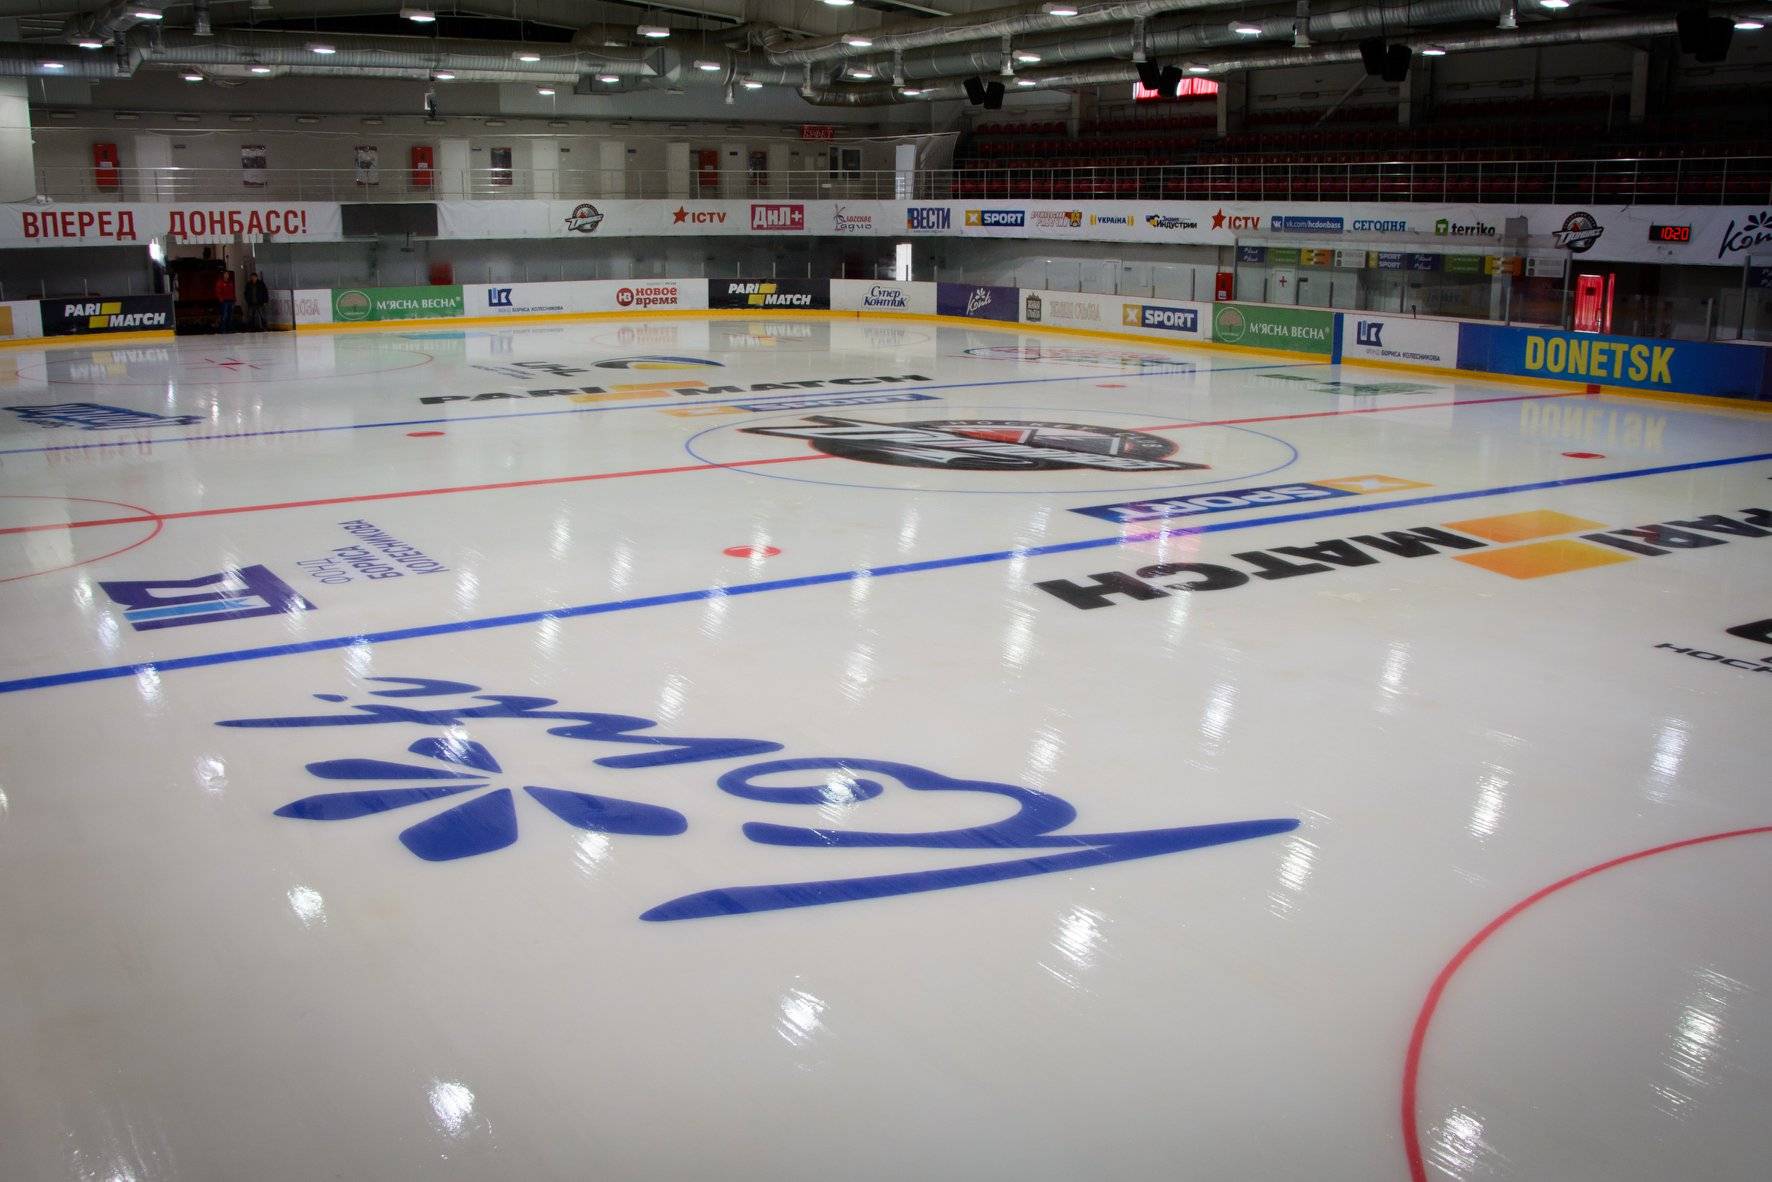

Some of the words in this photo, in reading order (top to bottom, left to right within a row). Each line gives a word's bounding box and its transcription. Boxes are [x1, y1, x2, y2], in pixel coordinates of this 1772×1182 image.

[22, 211, 137, 240] ВПЕРЕД
[169, 210, 307, 239] ДОНБАСС!
[692, 212, 727, 223] ICTV
[912, 208, 951, 229] ВЕСТИ
[983, 213, 1024, 225] SPORT
[1227, 216, 1261, 230] ICTV
[1353, 220, 1407, 233] СЕГОДНЯ
[1451, 222, 1496, 237] terriko
[635, 287, 678, 297] новое
[728, 283, 760, 294] PARI
[422, 298, 457, 309] ВЕСНА
[635, 296, 678, 308] время
[765, 294, 812, 306] MATCH
[65, 304, 101, 317] PARI
[110, 312, 166, 328] MATCH
[1145, 309, 1195, 329] SPORT
[1290, 326, 1325, 341] ВЕСНА
[1525, 336, 1675, 384] DONETSK
[674, 374, 938, 397] MATCH
[419, 387, 608, 405] PARI
[1101, 486, 1333, 522] SPORT
[337, 519, 451, 575] КОЛЕСНИКОВА
[332, 545, 405, 580] БОРИСА
[1036, 526, 1488, 610] MATCH
